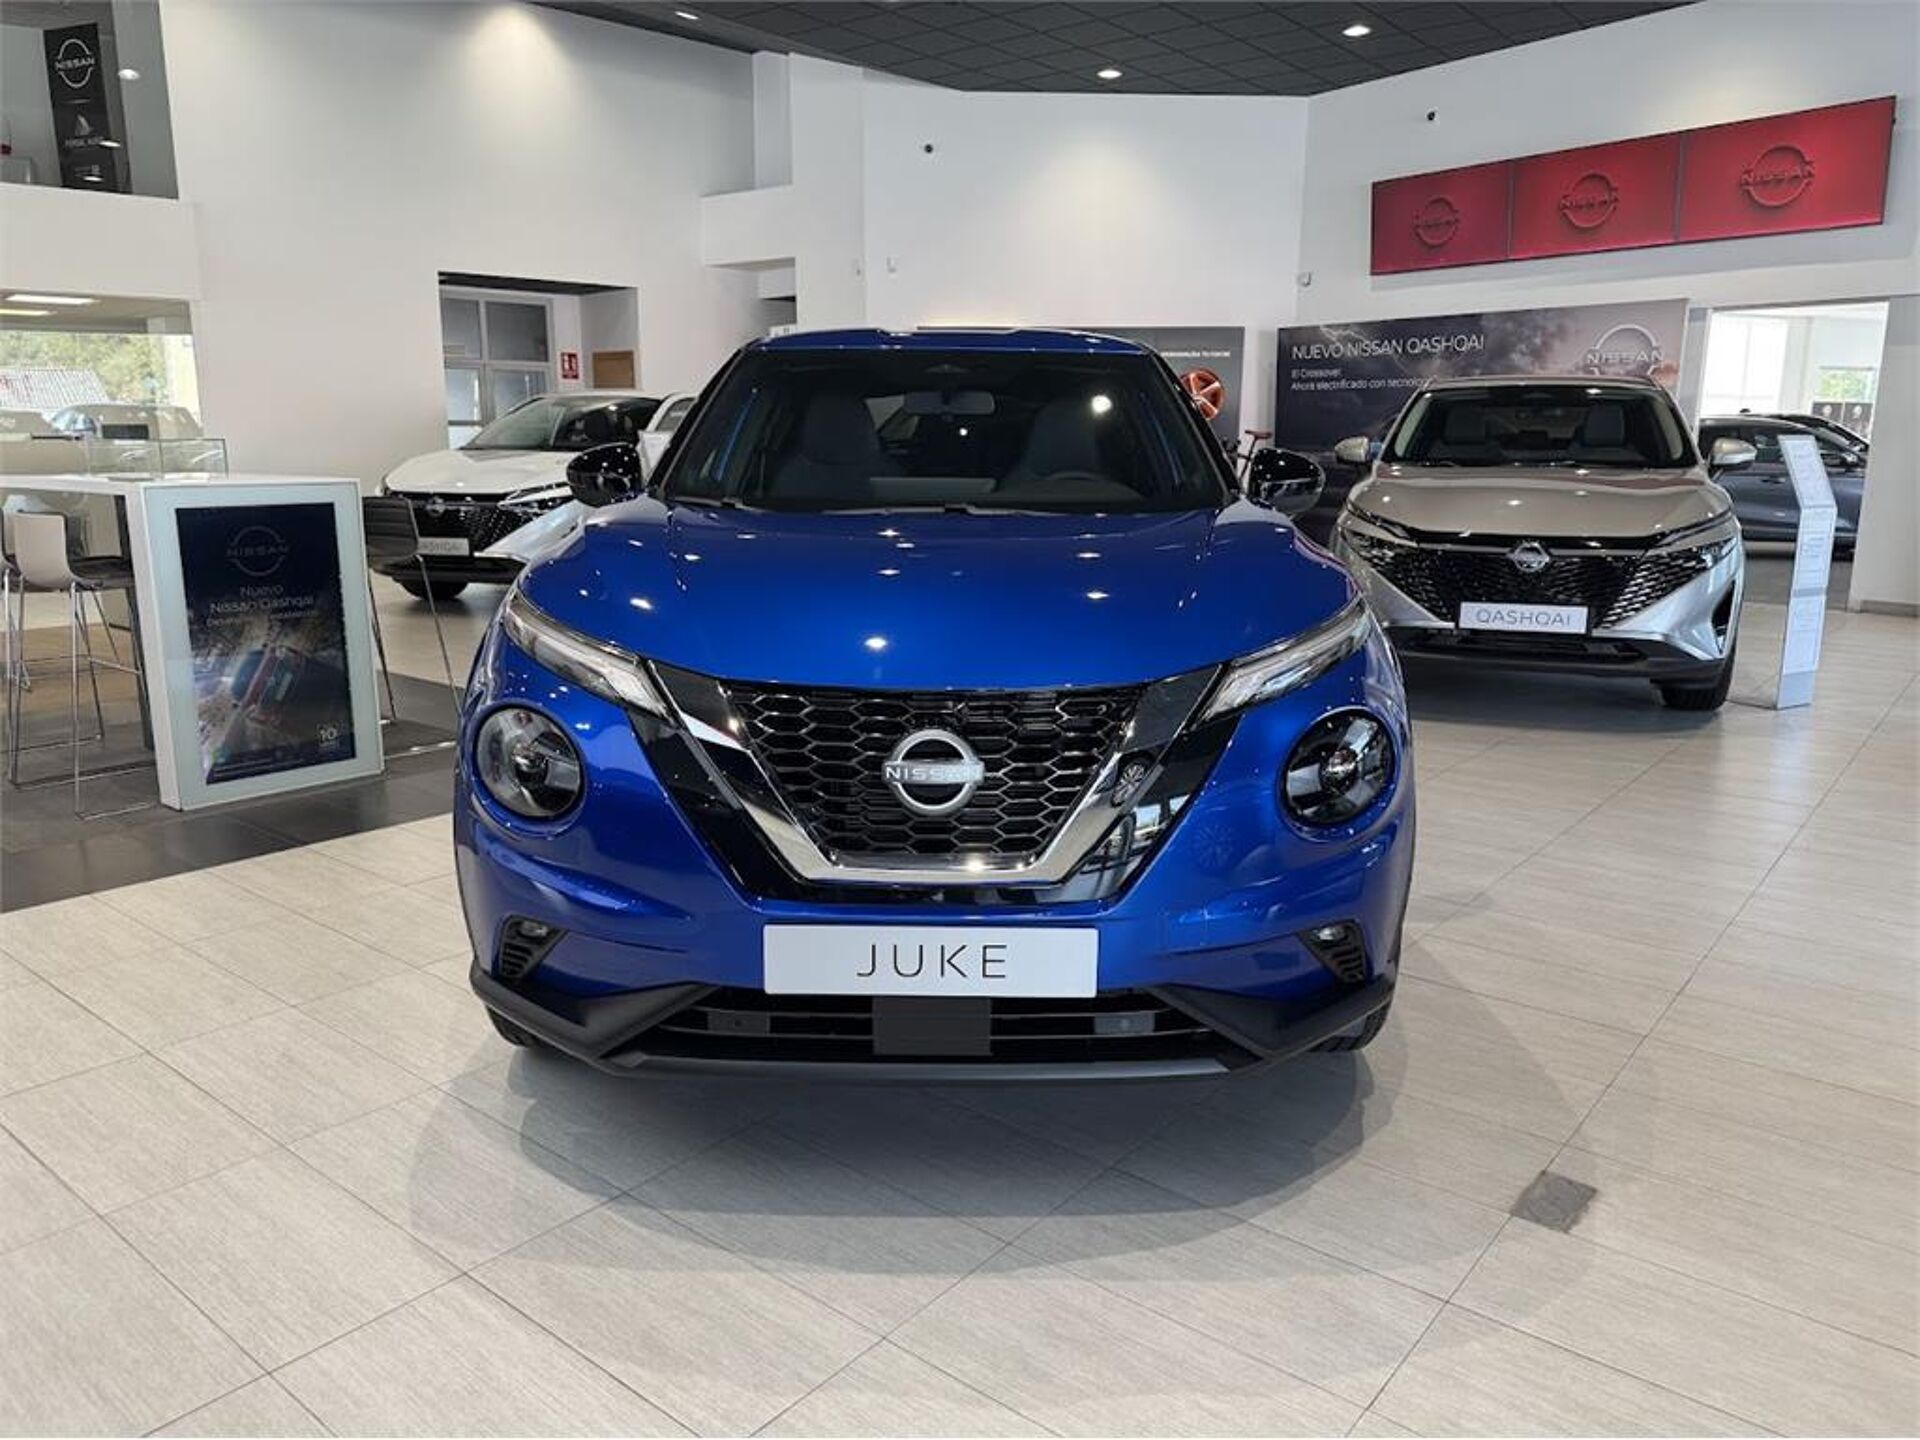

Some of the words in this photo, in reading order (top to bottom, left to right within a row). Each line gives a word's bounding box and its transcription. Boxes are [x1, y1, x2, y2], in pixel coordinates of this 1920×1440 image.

[1741, 163, 1815, 186] NISSAN
[1292, 342, 1344, 360] NUEVO
[1347, 339, 1403, 357] NISSAN
[1407, 334, 1485, 355] QASHQAI
[1476, 608, 1571, 627] QASHQAI
[856, 943, 1008, 979] JUKE
